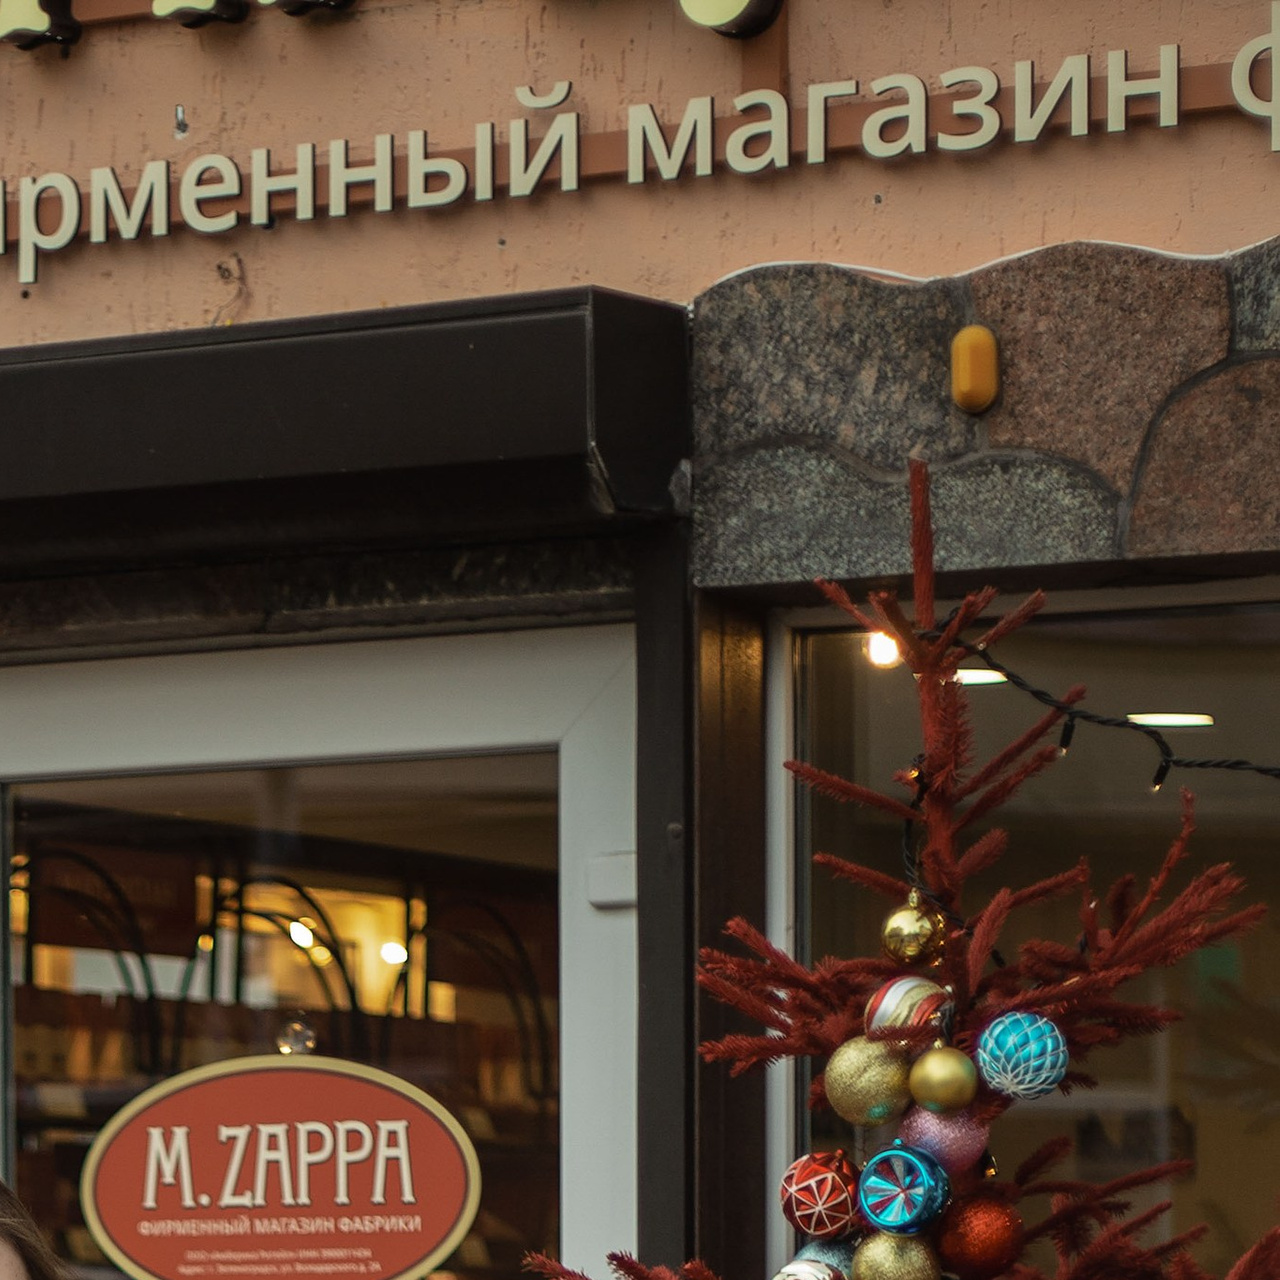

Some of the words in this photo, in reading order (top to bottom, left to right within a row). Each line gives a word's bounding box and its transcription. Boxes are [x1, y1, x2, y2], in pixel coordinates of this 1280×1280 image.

[627, 44, 1180, 184] магазин
[136, 1215, 251, 1236] ФИРМЕННЫЙ
[253, 1216, 335, 1235] МАГАЗИН
[336, 1214, 422, 1234] ФАБРИКИ
